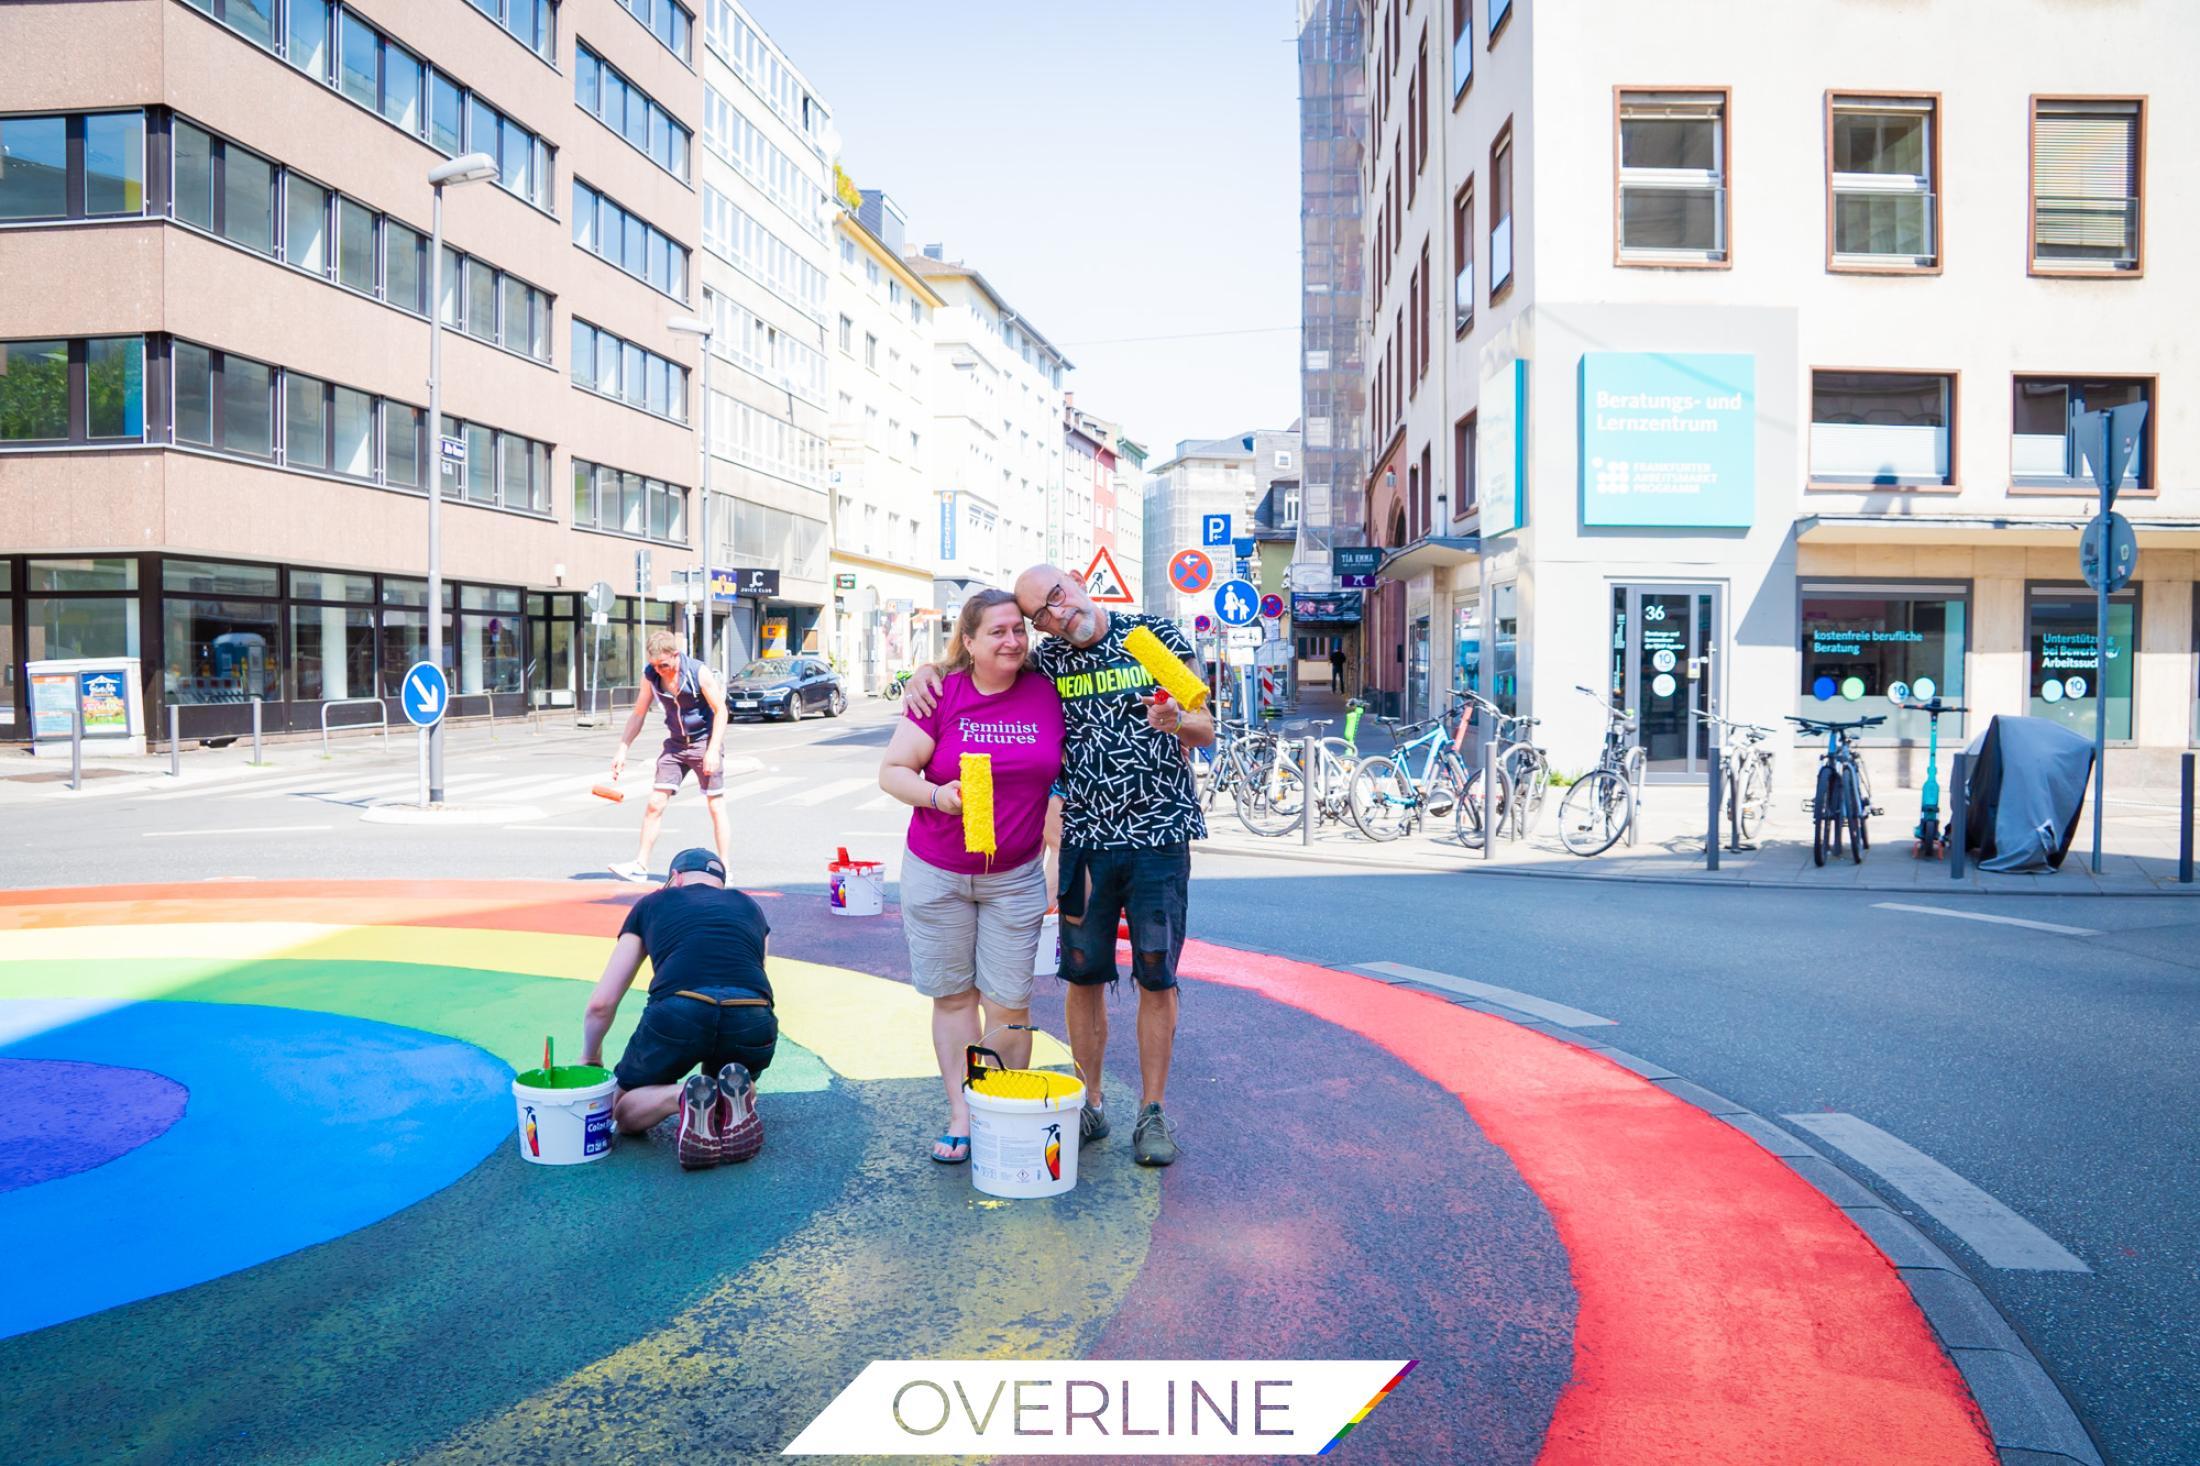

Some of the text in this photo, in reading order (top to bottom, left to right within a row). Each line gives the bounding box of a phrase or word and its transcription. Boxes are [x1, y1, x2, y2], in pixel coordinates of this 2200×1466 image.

[1597, 391, 1742, 412] Beratungs- und
[1597, 413, 1719, 432] Lernzentrum
[1209, 518, 1224, 542] P
[1645, 605, 1665, 620] 36
[1814, 630, 1923, 641] kostenfreie berufliche
[1814, 643, 1860, 655] Beratung
[2043, 645, 2058, 656] bei
[1057, 665, 1154, 698] NEON DEMON
[958, 717, 1039, 734] Feminist
[962, 729, 1037, 744] Futures
